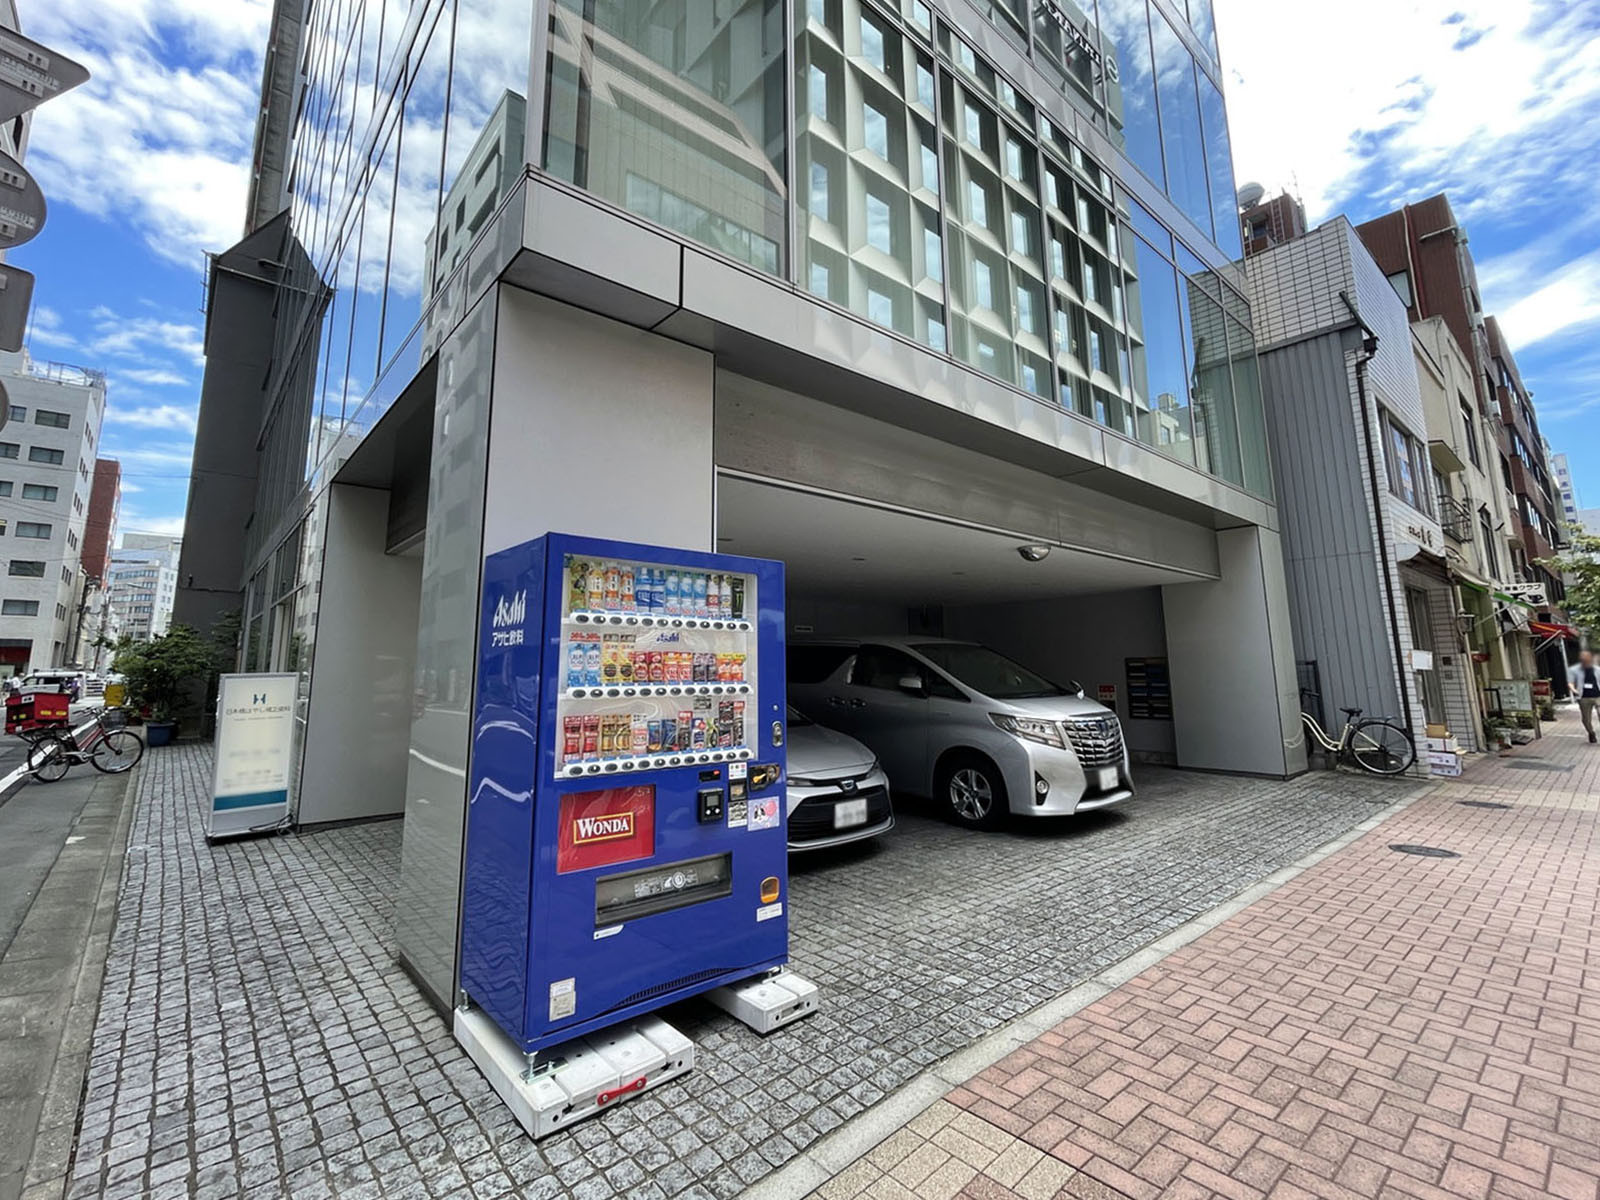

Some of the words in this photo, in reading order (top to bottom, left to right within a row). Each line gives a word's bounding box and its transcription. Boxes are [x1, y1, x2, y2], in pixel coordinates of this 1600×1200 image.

[493, 589, 527, 628] Asahi
[492, 629, 524, 647] アサヒ飲料
[656, 632, 679, 642] Asahi
[577, 817, 629, 839] WONDA
